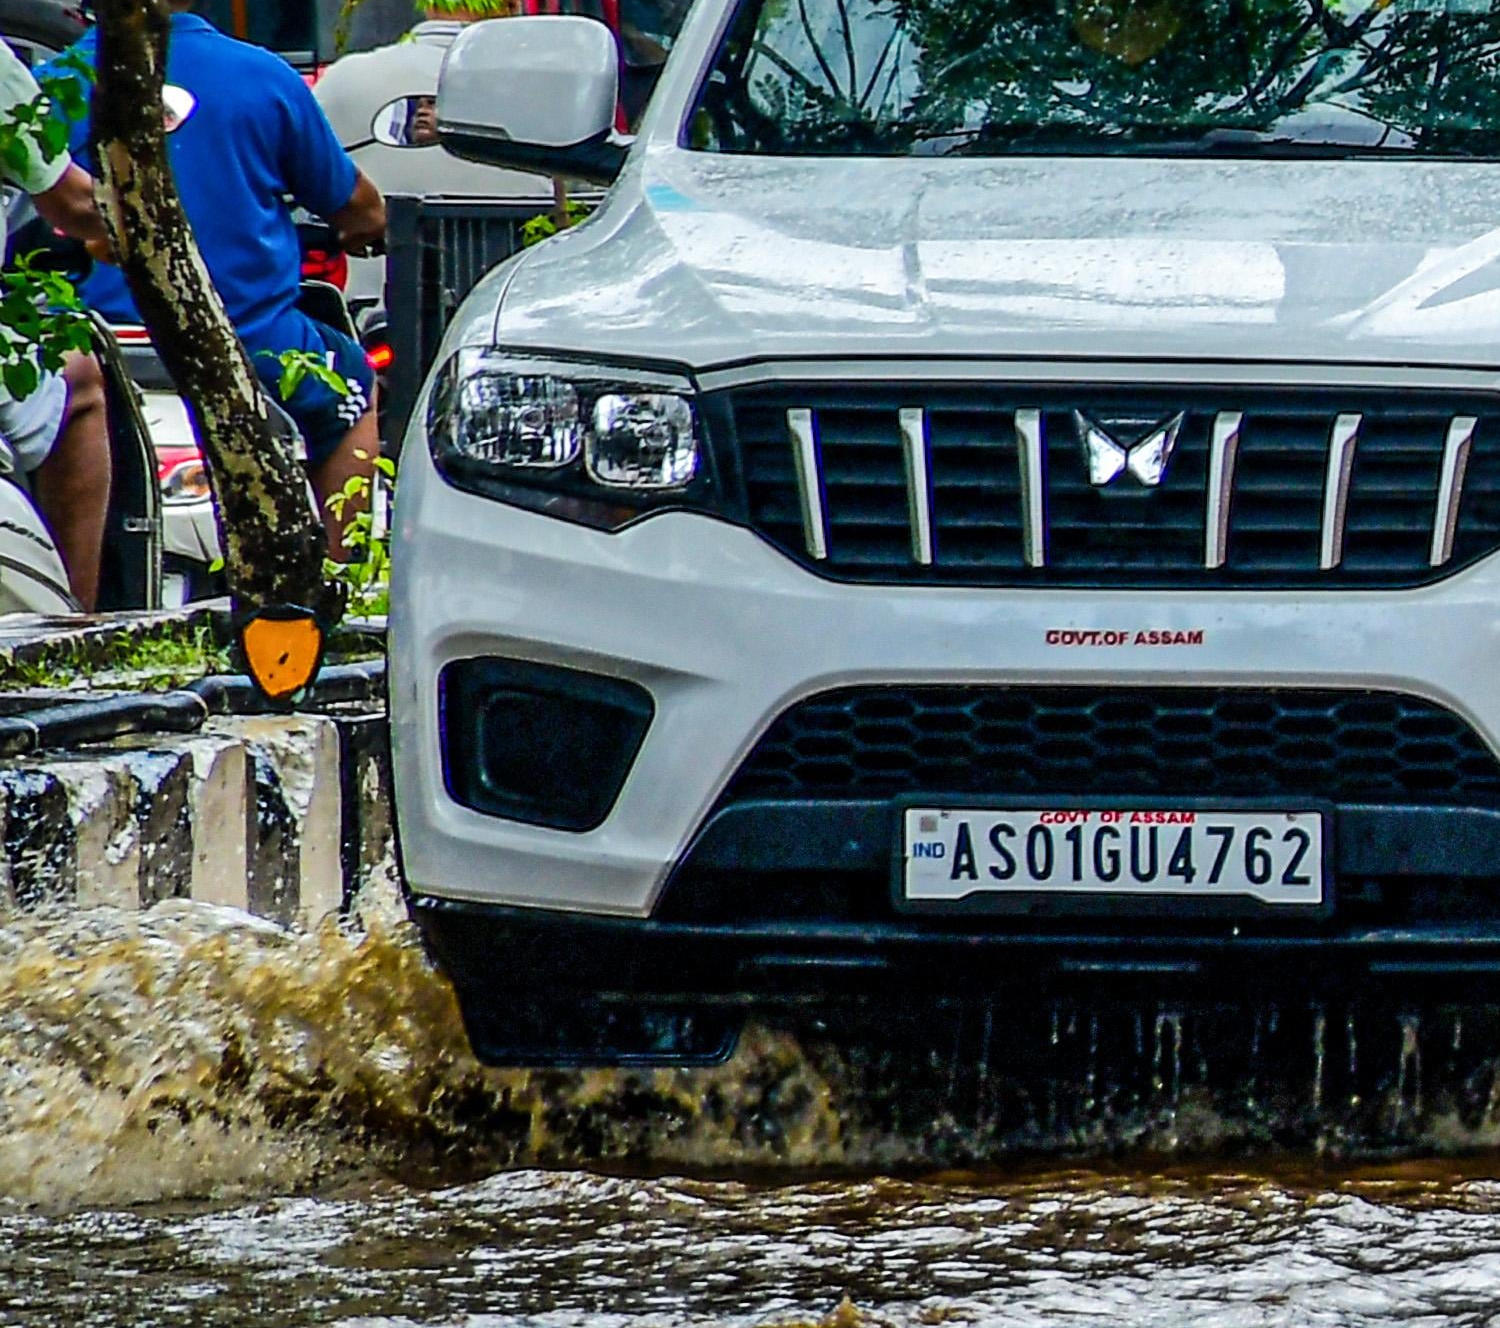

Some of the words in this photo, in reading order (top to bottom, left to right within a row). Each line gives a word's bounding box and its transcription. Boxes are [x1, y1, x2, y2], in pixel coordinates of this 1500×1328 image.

[1134, 629, 1205, 645] ASSAM
[1039, 811, 1090, 825] GOVT
[1100, 811, 1126, 824] OF
[1129, 811, 1197, 825] ASSAM
[913, 841, 946, 859] IND
[950, 821, 1312, 887] AS01GU4762
